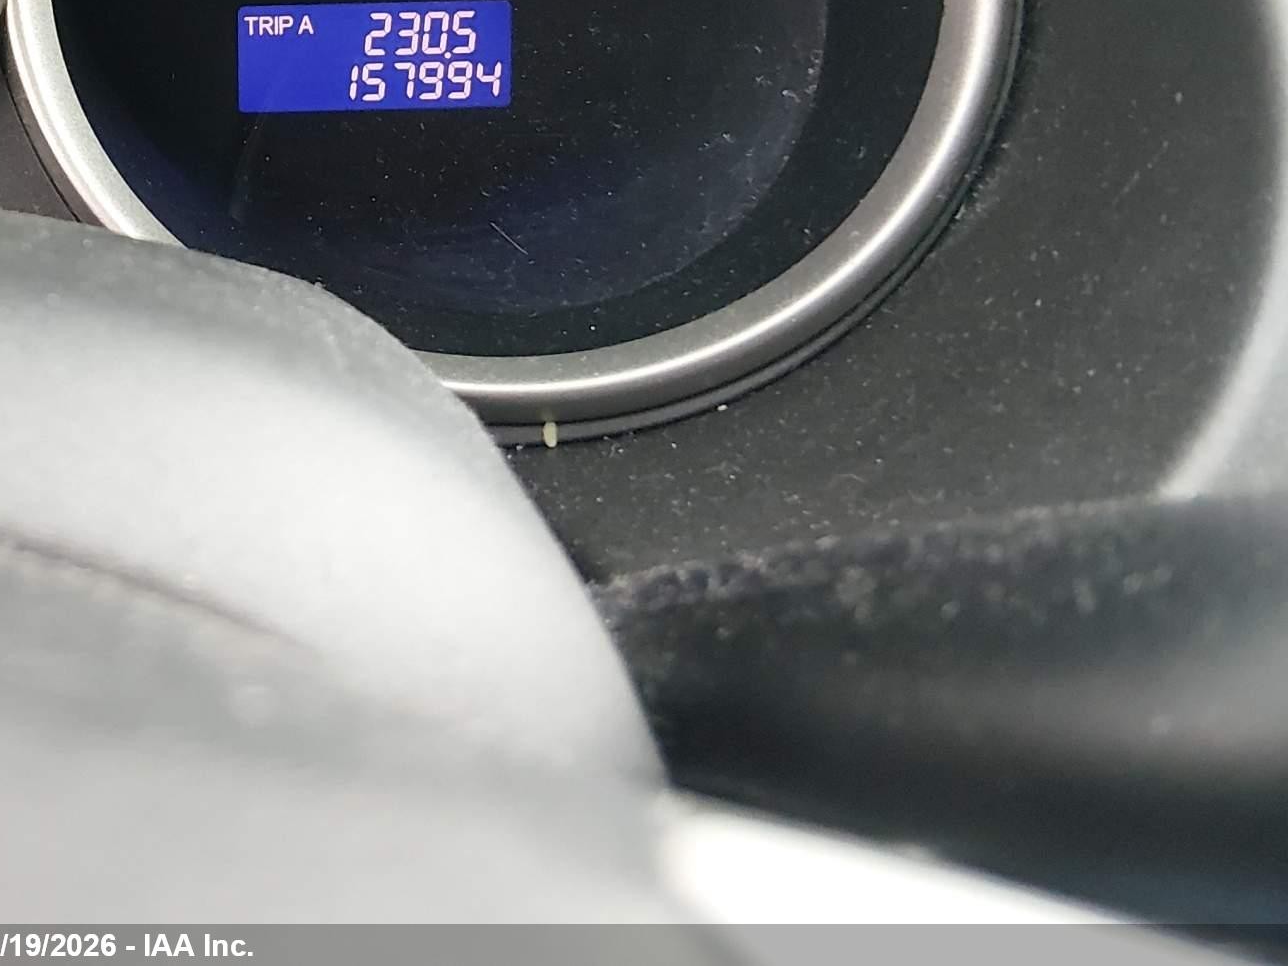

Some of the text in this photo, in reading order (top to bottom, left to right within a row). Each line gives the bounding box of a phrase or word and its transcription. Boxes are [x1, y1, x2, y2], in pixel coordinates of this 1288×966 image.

[244, 16, 314, 35] TRIP A
[349, 61, 501, 102] 157994
